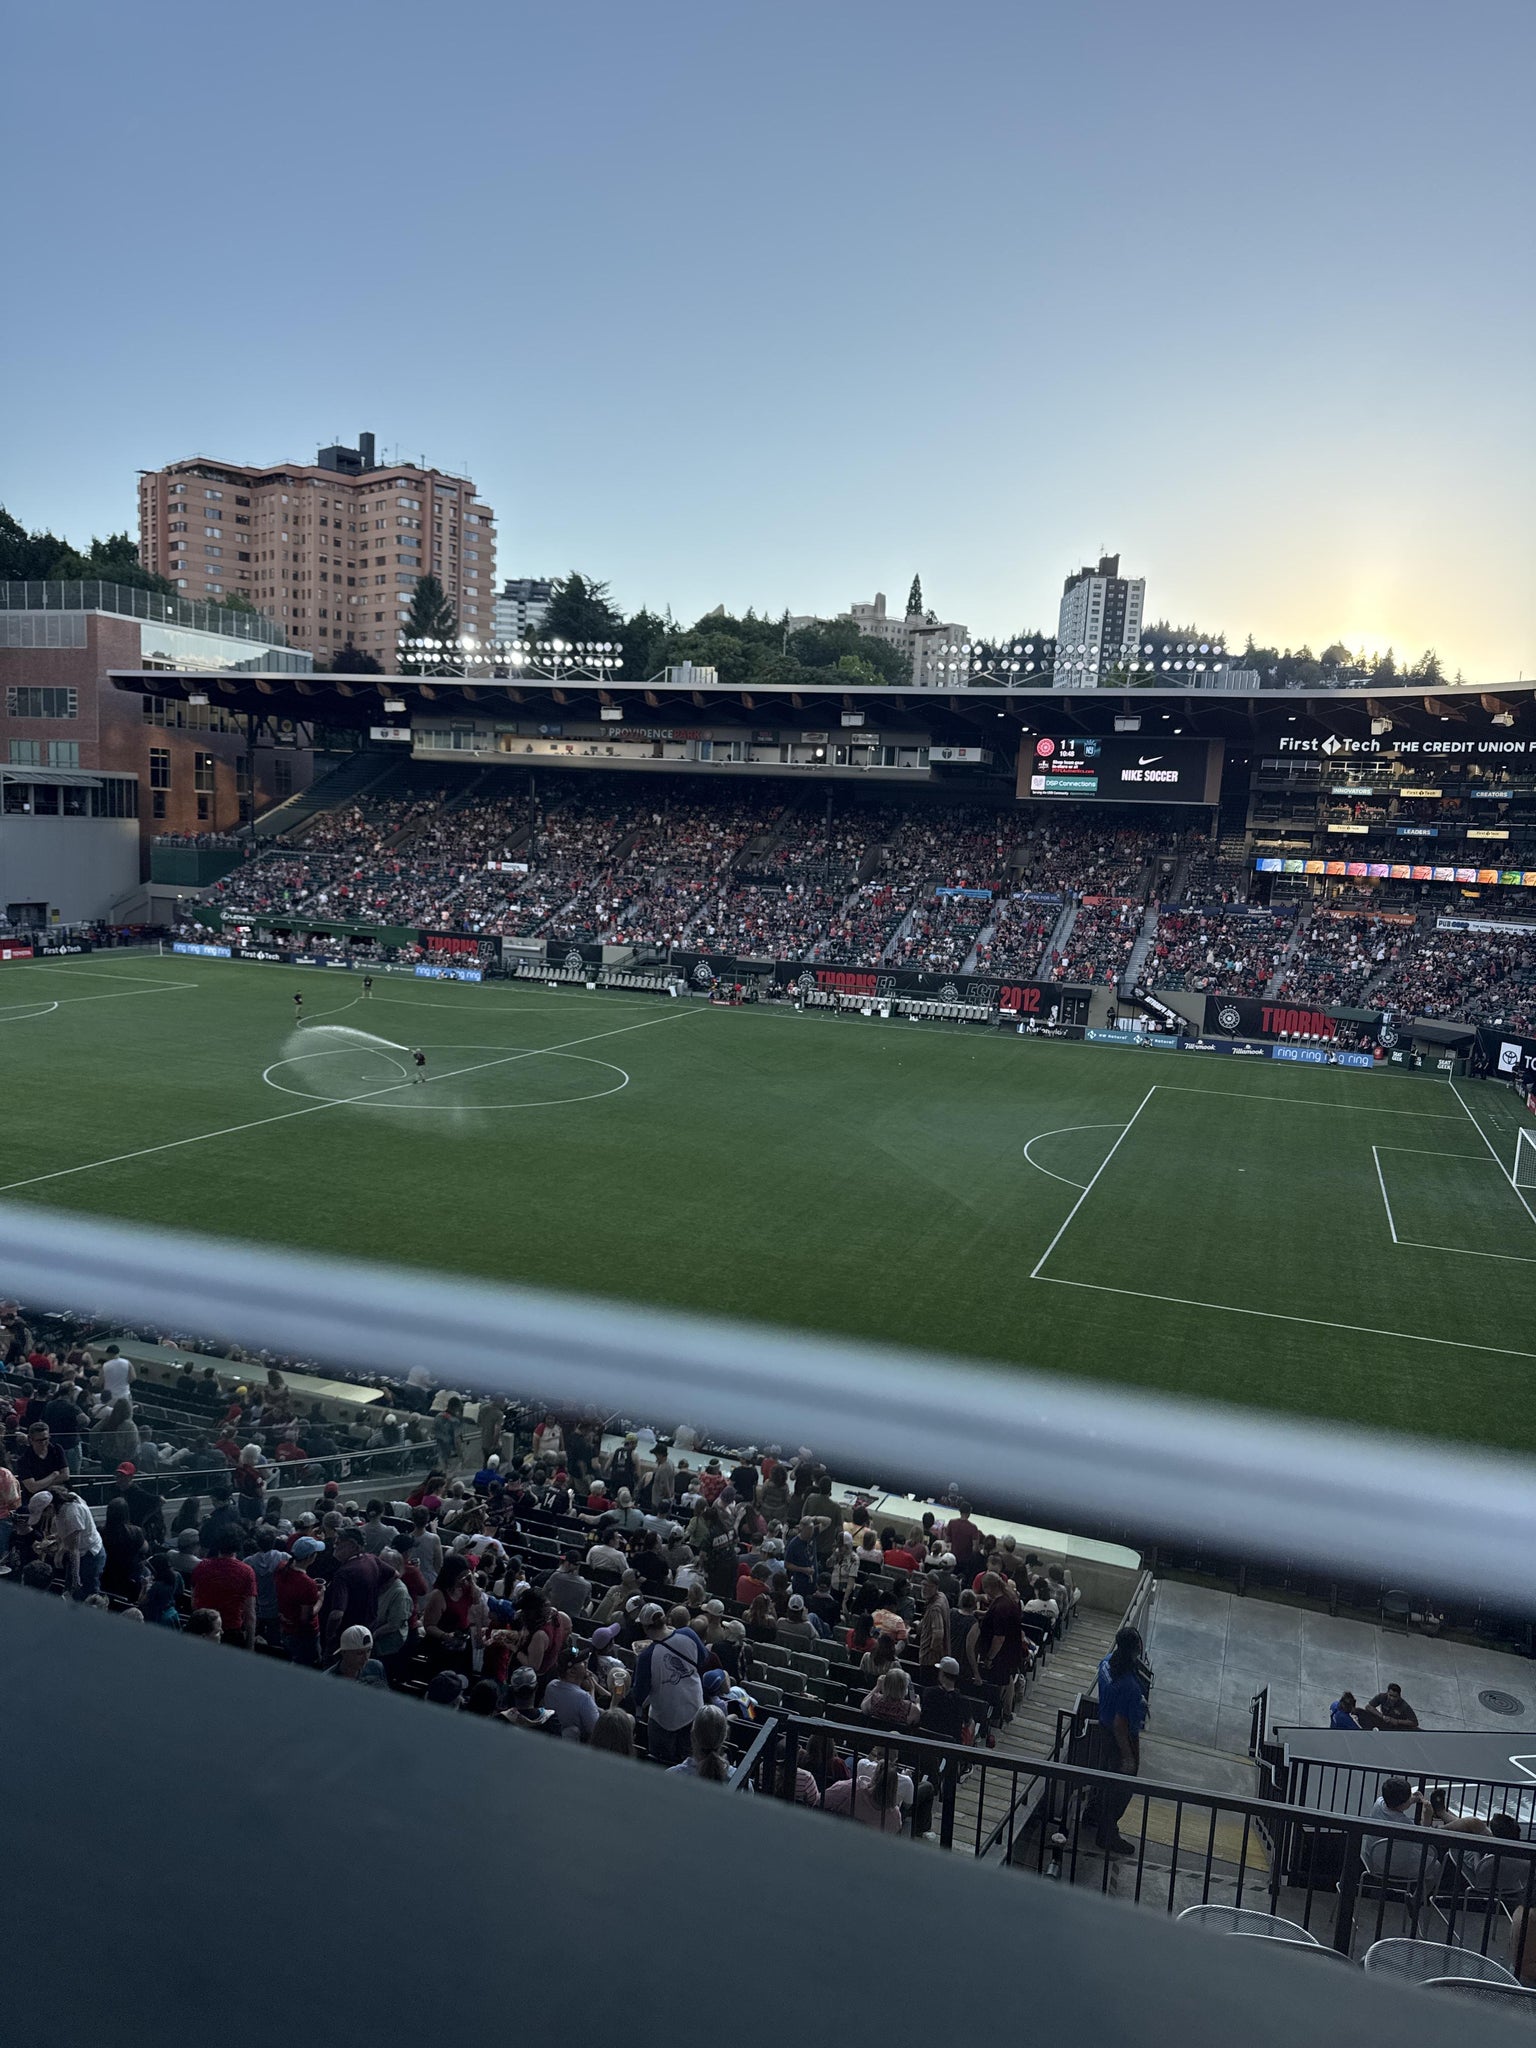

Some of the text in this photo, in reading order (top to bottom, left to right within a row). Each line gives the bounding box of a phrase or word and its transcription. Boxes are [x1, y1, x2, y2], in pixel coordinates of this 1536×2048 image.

[608, 727, 700, 739] PROVIDENCE PARK
[1060, 739, 1075, 750] 1 1
[1279, 737, 1319, 751] First
[1342, 738, 1381, 752] Tech
[1392, 741, 1420, 752] THE
[1422, 741, 1475, 753] CREDIT
[1477, 741, 1526, 753] UNION
[1121, 769, 1179, 782] NIKE SOCCER
[1332, 787, 1371, 795] INNOVATORS
[1438, 920, 1451, 928] PUB
[43, 945, 82, 955] First Tech
[187, 943, 200, 955] ring
[203, 944, 217, 956] ring
[217, 947, 231, 958] ring
[426, 935, 478, 958] THORNS
[240, 951, 280, 960] First Tech
[416, 966, 431, 977] ring
[466, 971, 481, 982] ring
[815, 970, 878, 998] THORNS
[1000, 985, 1041, 1012] 2012
[1261, 1006, 1337, 1039] THORNS
[1232, 1047, 1265, 1056] Tillamook
[1276, 1047, 1298, 1060] ring
[1300, 1049, 1323, 1063] ring
[1347, 1053, 1370, 1067] ring
[1392, 1050, 1403, 1058] SEAT
[1391, 1055, 1403, 1063] GEEK
[1438, 1058, 1452, 1066] SEAT
[543, 1492, 557, 1508] 14
